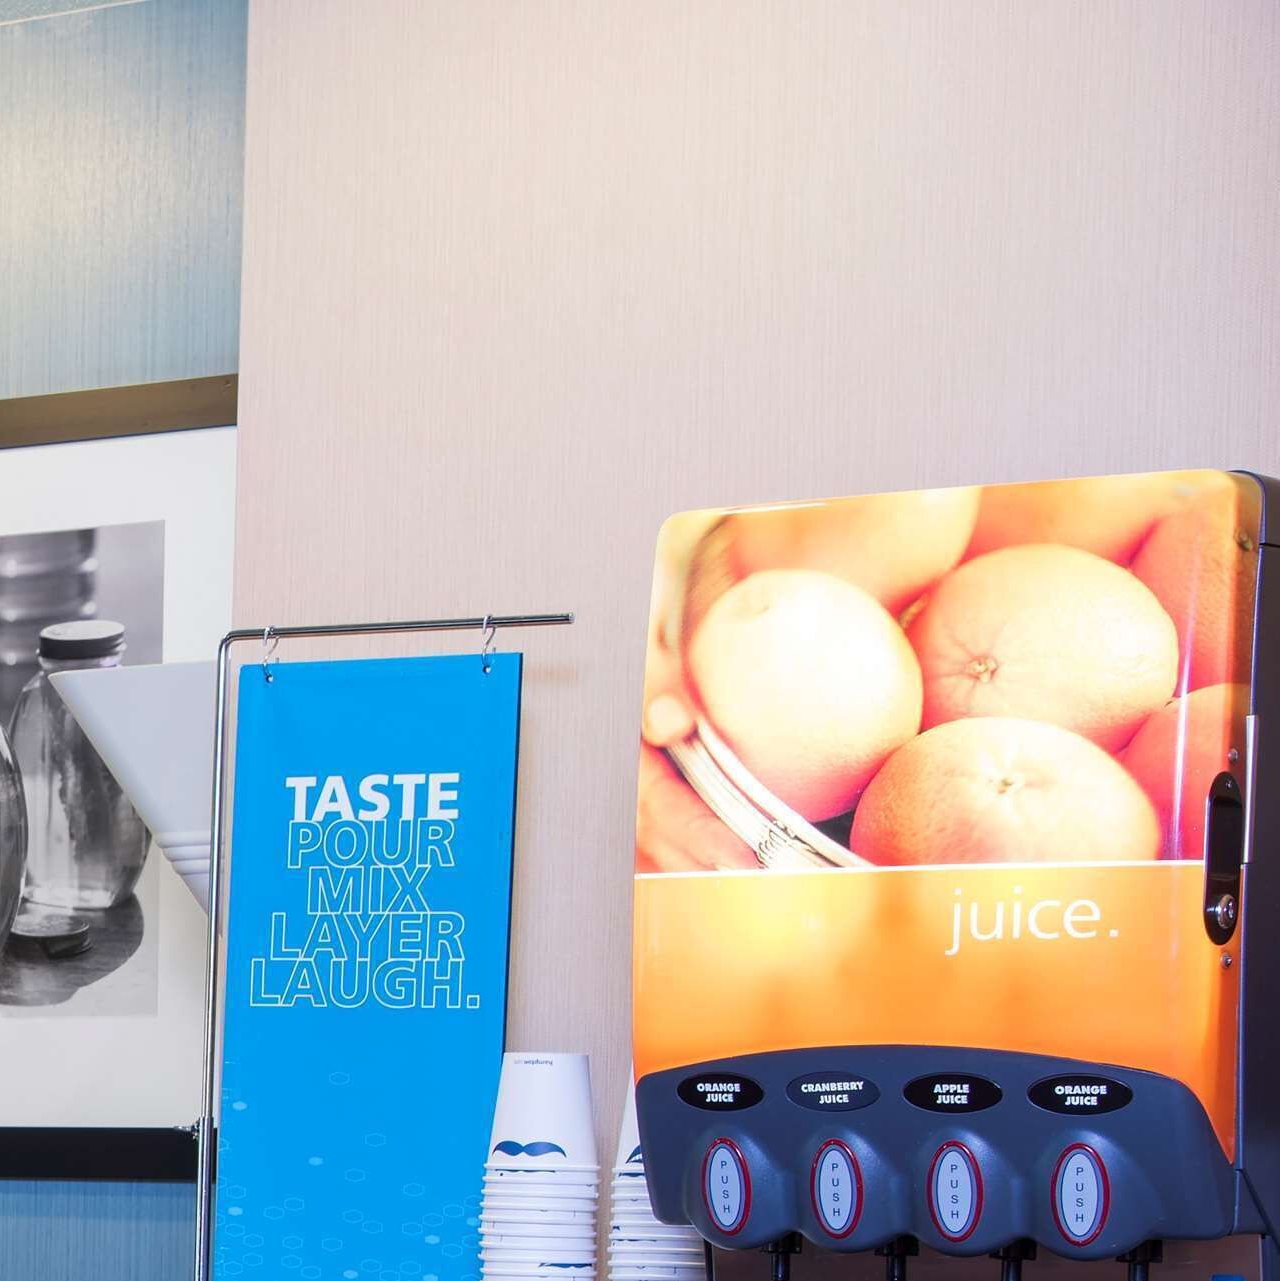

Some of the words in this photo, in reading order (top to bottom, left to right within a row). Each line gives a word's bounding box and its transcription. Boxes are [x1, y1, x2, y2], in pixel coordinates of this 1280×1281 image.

[285, 773, 460, 823] TASTE
[288, 818, 455, 869] POUR
[308, 864, 431, 915] MIX
[270, 912, 465, 961] LAYER
[944, 886, 1120, 956] juice.
[250, 958, 480, 1008] LAUGH.
[697, 1083, 741, 1093] ORANGE
[705, 1093, 734, 1103] JUICE
[801, 1081, 864, 1093] CRANBERRY
[819, 1094, 849, 1104] JUICE
[933, 1084, 970, 1094] APPLE
[936, 1094, 968, 1104] JUICE
[1054, 1085, 1108, 1095] ORANGE
[1064, 1096, 1098, 1106] JUICE
[720, 1160, 731, 1213] PUSH
[831, 1163, 841, 1217] PUSH
[950, 1164, 960, 1219] PUSH
[1075, 1167, 1084, 1223] PUSH
